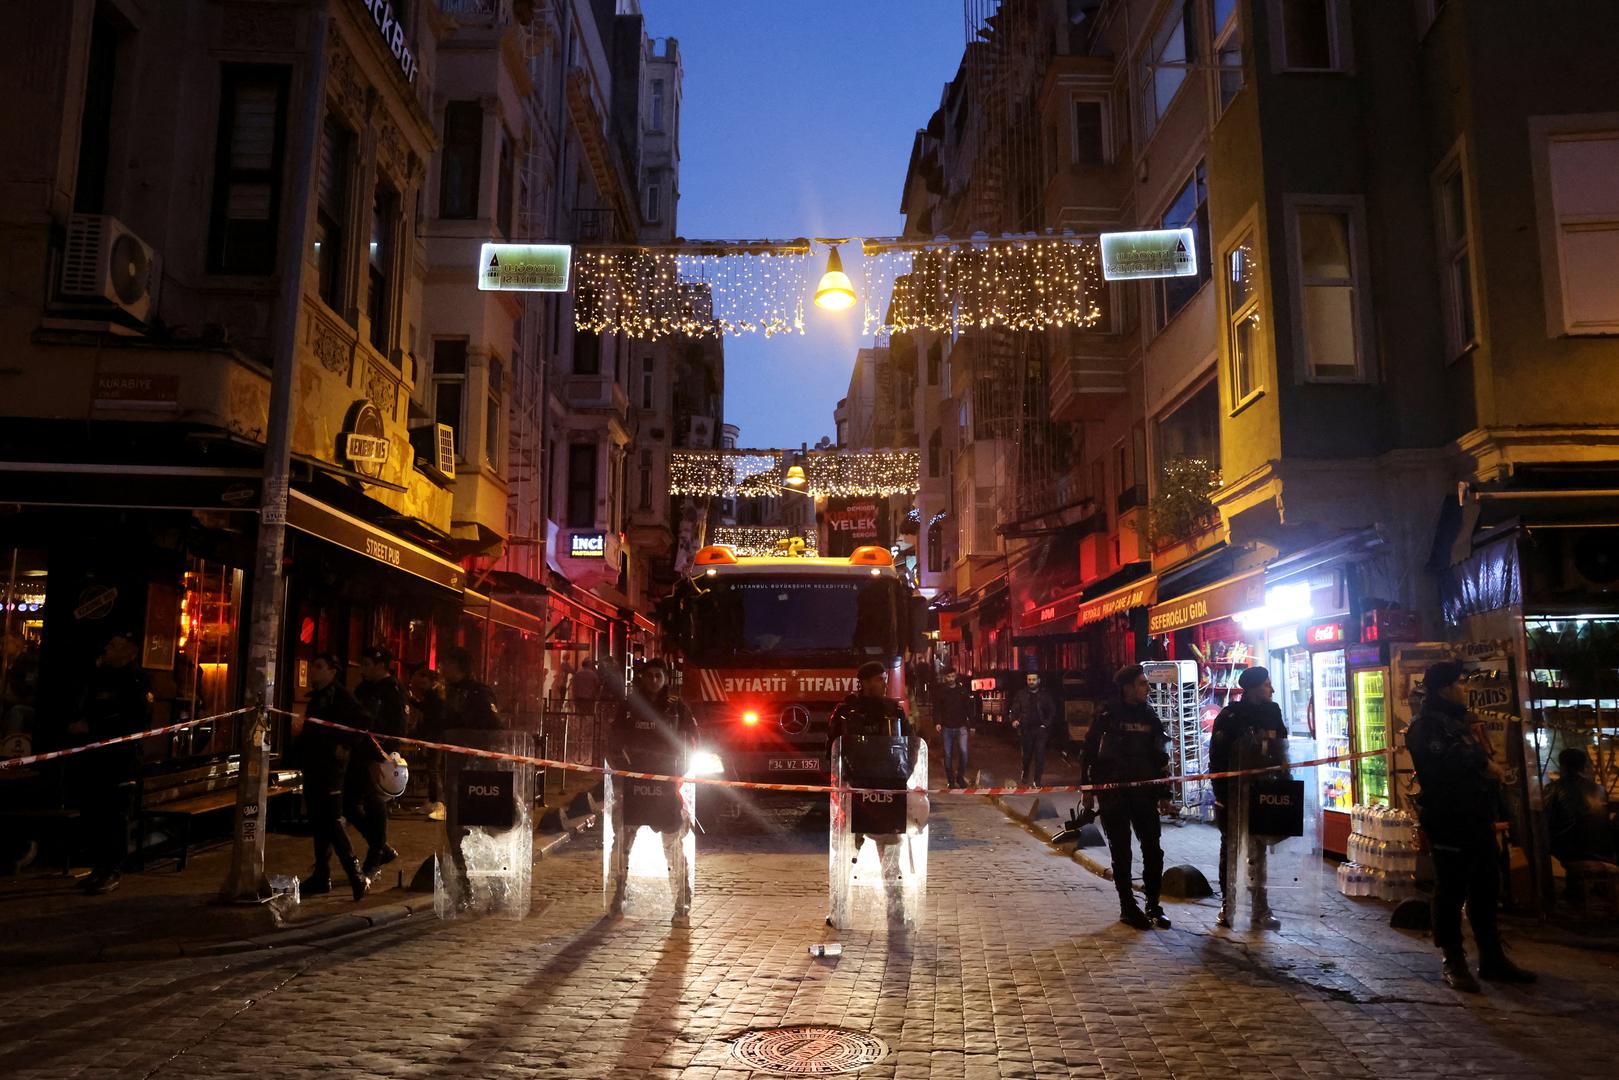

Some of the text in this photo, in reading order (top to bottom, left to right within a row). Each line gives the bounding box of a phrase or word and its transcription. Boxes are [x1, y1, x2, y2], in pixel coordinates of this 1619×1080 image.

[831, 518, 876, 531] YELEK
[572, 535, 603, 550] İNCİ
[366, 537, 400, 565] STREET PUB
[1189, 600, 1208, 620] GIDA
[774, 760, 818, 769] 34 VZ 1357
